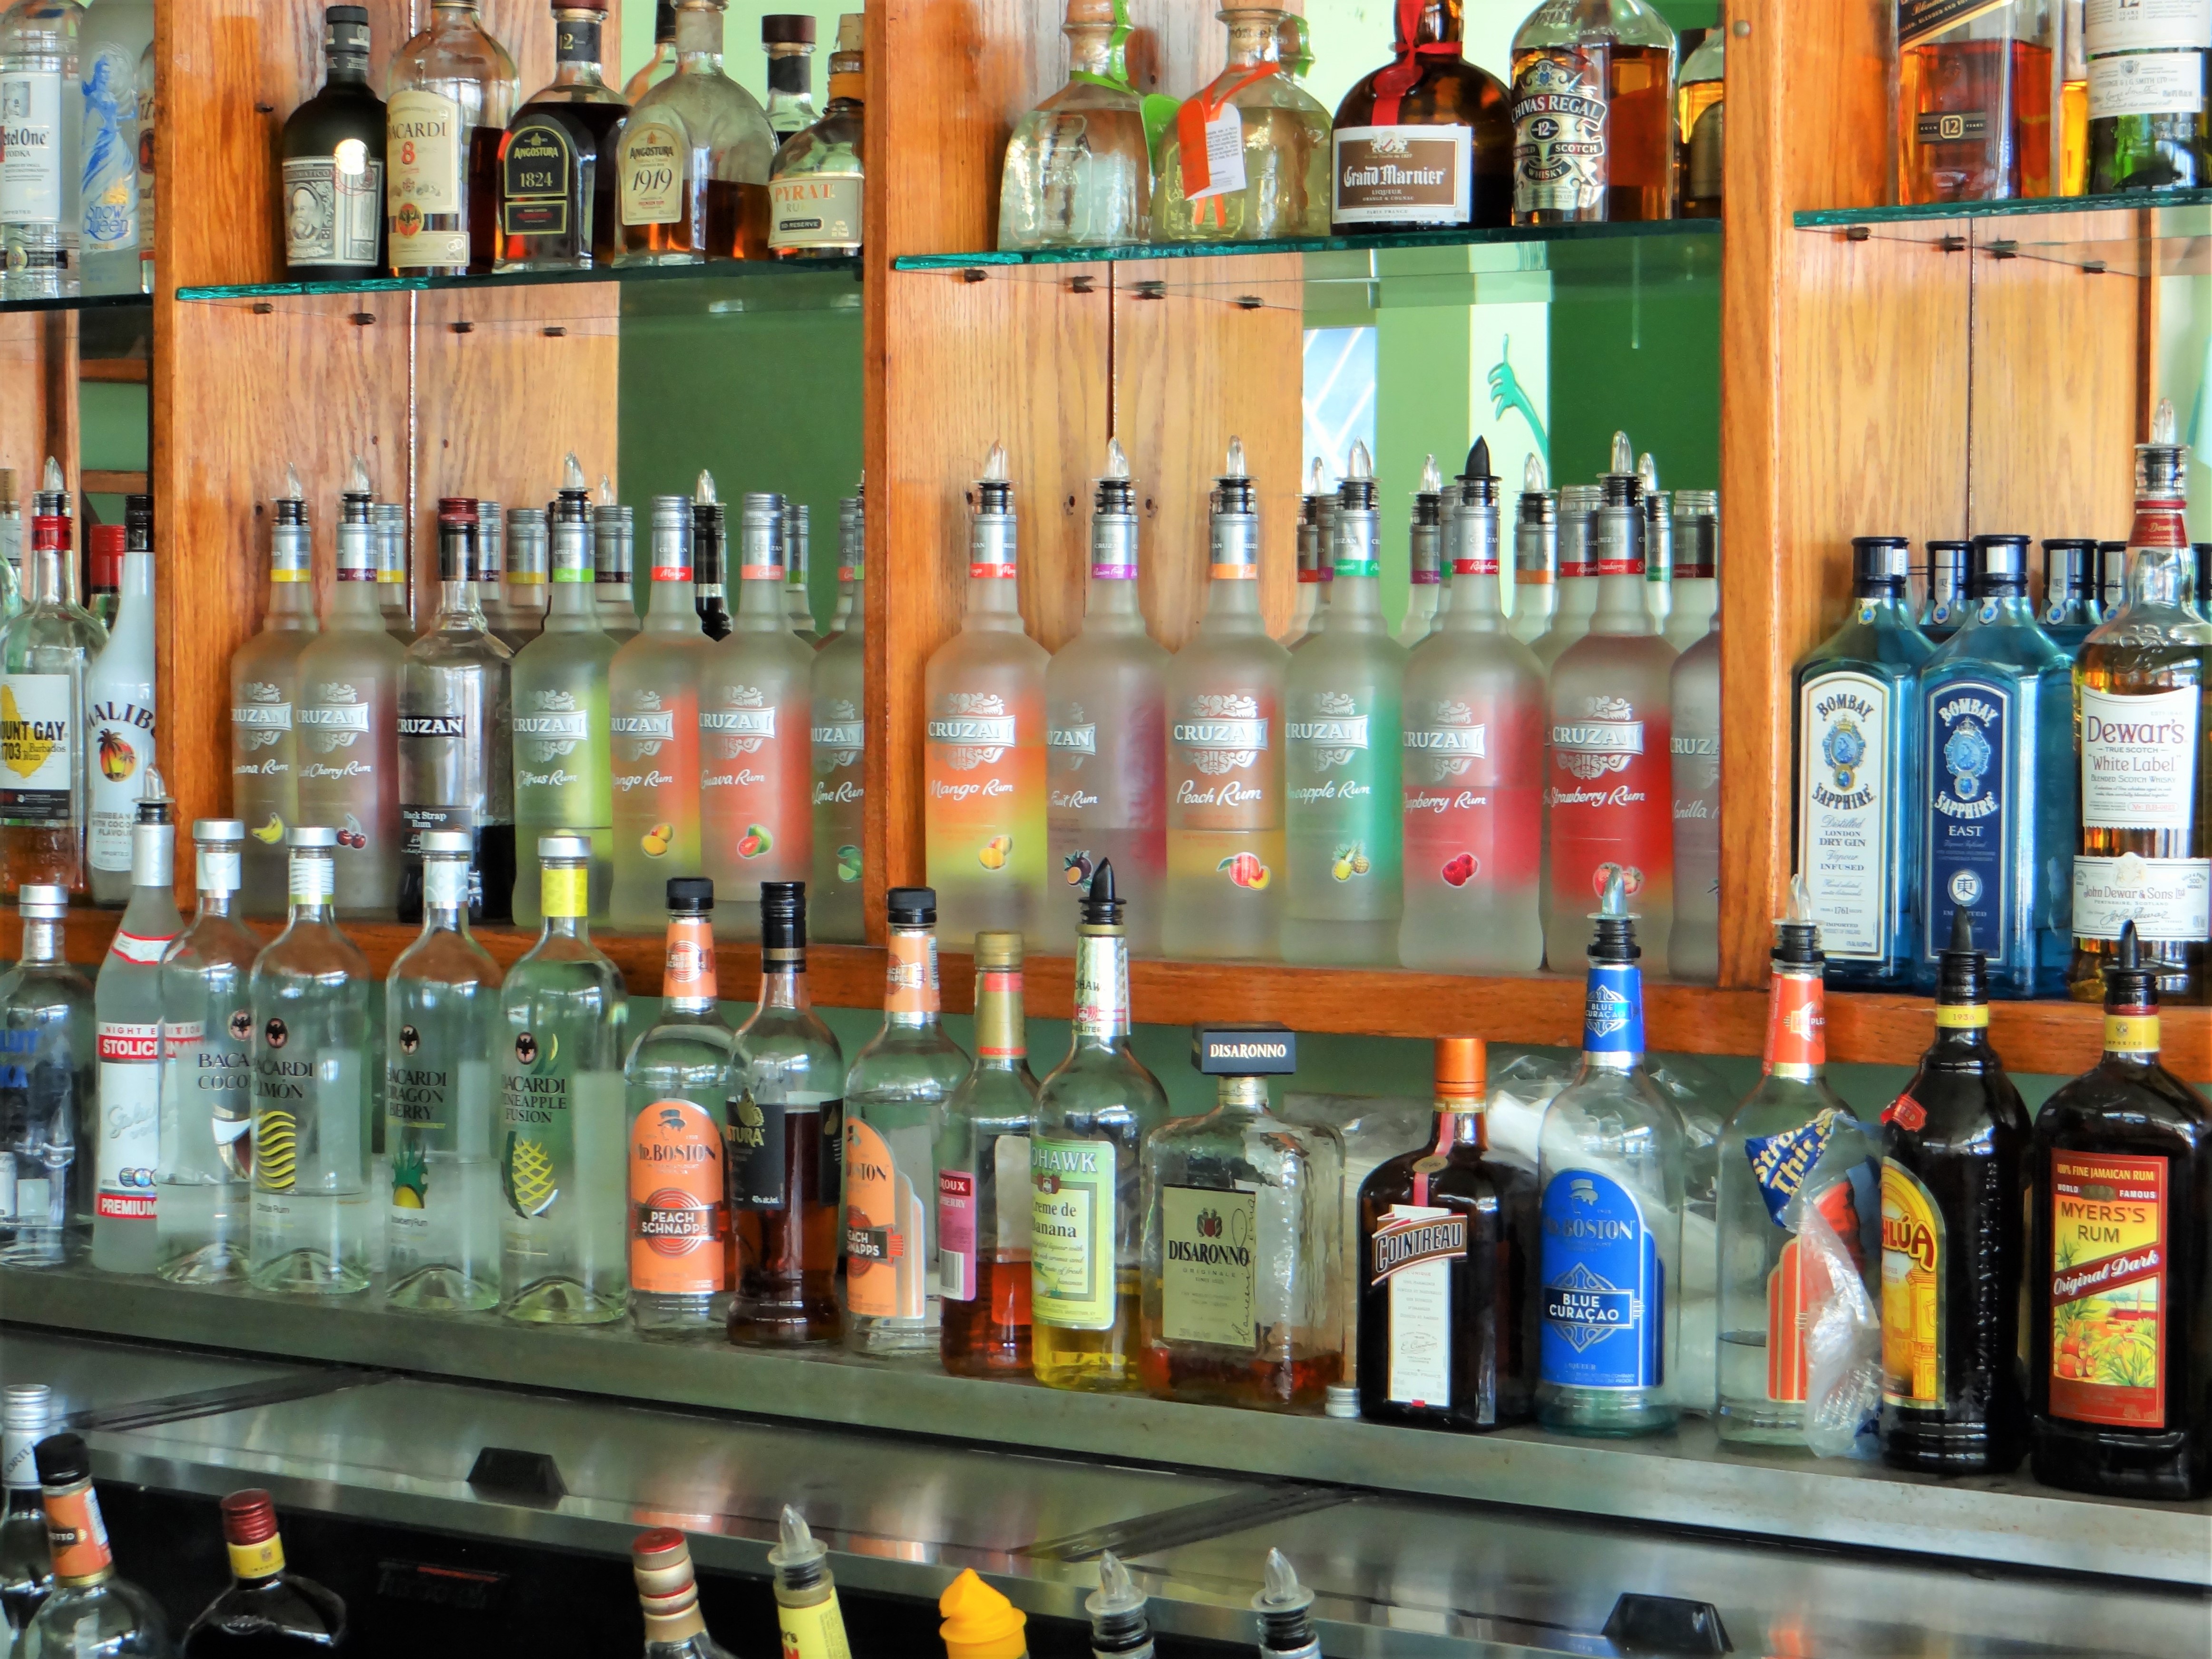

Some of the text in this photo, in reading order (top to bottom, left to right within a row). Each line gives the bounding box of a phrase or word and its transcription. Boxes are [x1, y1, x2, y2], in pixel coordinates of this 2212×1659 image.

[1512, 95, 1598, 123] CHIVAS REGAL
[1538, 121, 1550, 136] 12
[1944, 120, 1959, 134] 12
[20, 128, 47, 146] One
[401, 141, 415, 165] 8
[514, 146, 559, 159] ANGOSTURA
[629, 146, 674, 160] ANGOSTURA
[1555, 144, 1598, 153] SCOTCH
[519, 172, 553, 188] 1824
[1344, 164, 1445, 187] Grand Marnier
[1528, 166, 1564, 179] WHISKY
[632, 168, 673, 196] 1919
[775, 184, 833, 203] PYRAT
[87, 203, 125, 220] Snow
[83, 219, 129, 238] Queen
[1816, 693, 1875, 722] BOMBAY
[1939, 697, 2000, 727] BOMBAY
[88, 701, 156, 740] ALIB
[296, 709, 364, 724] CRUZAN
[700, 712, 771, 729] CRUZAN
[34, 720, 66, 741] GAY
[397, 719, 463, 734] CRUZAN
[513, 718, 584, 733] CRUZAN
[928, 721, 1012, 738] CRUZAN
[1173, 724, 1264, 742] CRUZAN
[1286, 722, 1364, 740] CRUZAN
[2086, 716, 2185, 744] Dewar's
[1403, 730, 1482, 749] CRUZAN
[1552, 726, 1640, 747] CRUZAN
[1, 742, 66, 761] 1703 Barbados
[262, 758, 289, 774] Rum
[310, 763, 344, 780] Cherry
[343, 760, 372, 776] Rum
[516, 769, 577, 789] Citrus Rum
[612, 770, 673, 792] ango Rum
[735, 769, 765, 786] Rum
[930, 778, 1013, 802] Mango Rum
[1176, 779, 1262, 807] Peach Rum
[1337, 780, 1371, 799] Rum
[1550, 785, 1646, 808] Strawberry Rum
[1812, 782, 1876, 810] SAPPHIRE
[1069, 790, 1098, 808] Rum
[1454, 791, 1487, 809] Rum
[1934, 791, 1999, 819] SAPPHIRE
[412, 820, 431, 828] Rum
[421, 811, 447, 822] Strap
[1821, 815, 1867, 829] Distilled
[1949, 825, 1984, 837] EAST
[1819, 837, 1866, 847] DRY GIN
[1826, 850, 1859, 863] Vapour
[1820, 863, 1865, 871] INFUSED
[2083, 885, 2186, 900] John Dewar & Sons Ltd
[1834, 906, 1849, 914] 1761
[1585, 1010, 1626, 1019] CURAÇAO
[106, 1025, 142, 1036] NIGHT
[1209, 1044, 1287, 1059] DISARONNO
[501, 1074, 566, 1094] BACARDI
[388, 1086, 444, 1103] RAGON
[389, 1102, 434, 1120] BERRY
[505, 1107, 553, 1124] FUSION
[653, 1144, 716, 1162] BOSTON
[2073, 1165, 2089, 1177] FINE
[2091, 1167, 2131, 1180] JAMAICAN
[2133, 1169, 2155, 1181] RUM
[2057, 1184, 2156, 1199] WORLD FAMOUS
[101, 1198, 157, 1216] PREMIUM
[1061, 1201, 1077, 1217] de
[2060, 1200, 2146, 1223] MYERS'S
[651, 1211, 695, 1223] PEACH
[642, 1222, 708, 1235] SCHNAPPS
[1168, 1239, 1250, 1267] DISARONNO
[1375, 1223, 1462, 1273] COINTREAU
[1182, 1268, 1237, 1279] ORIGINALE
[1562, 1294, 1600, 1308] BLUE
[1549, 1305, 1619, 1323] CURAÇAO
